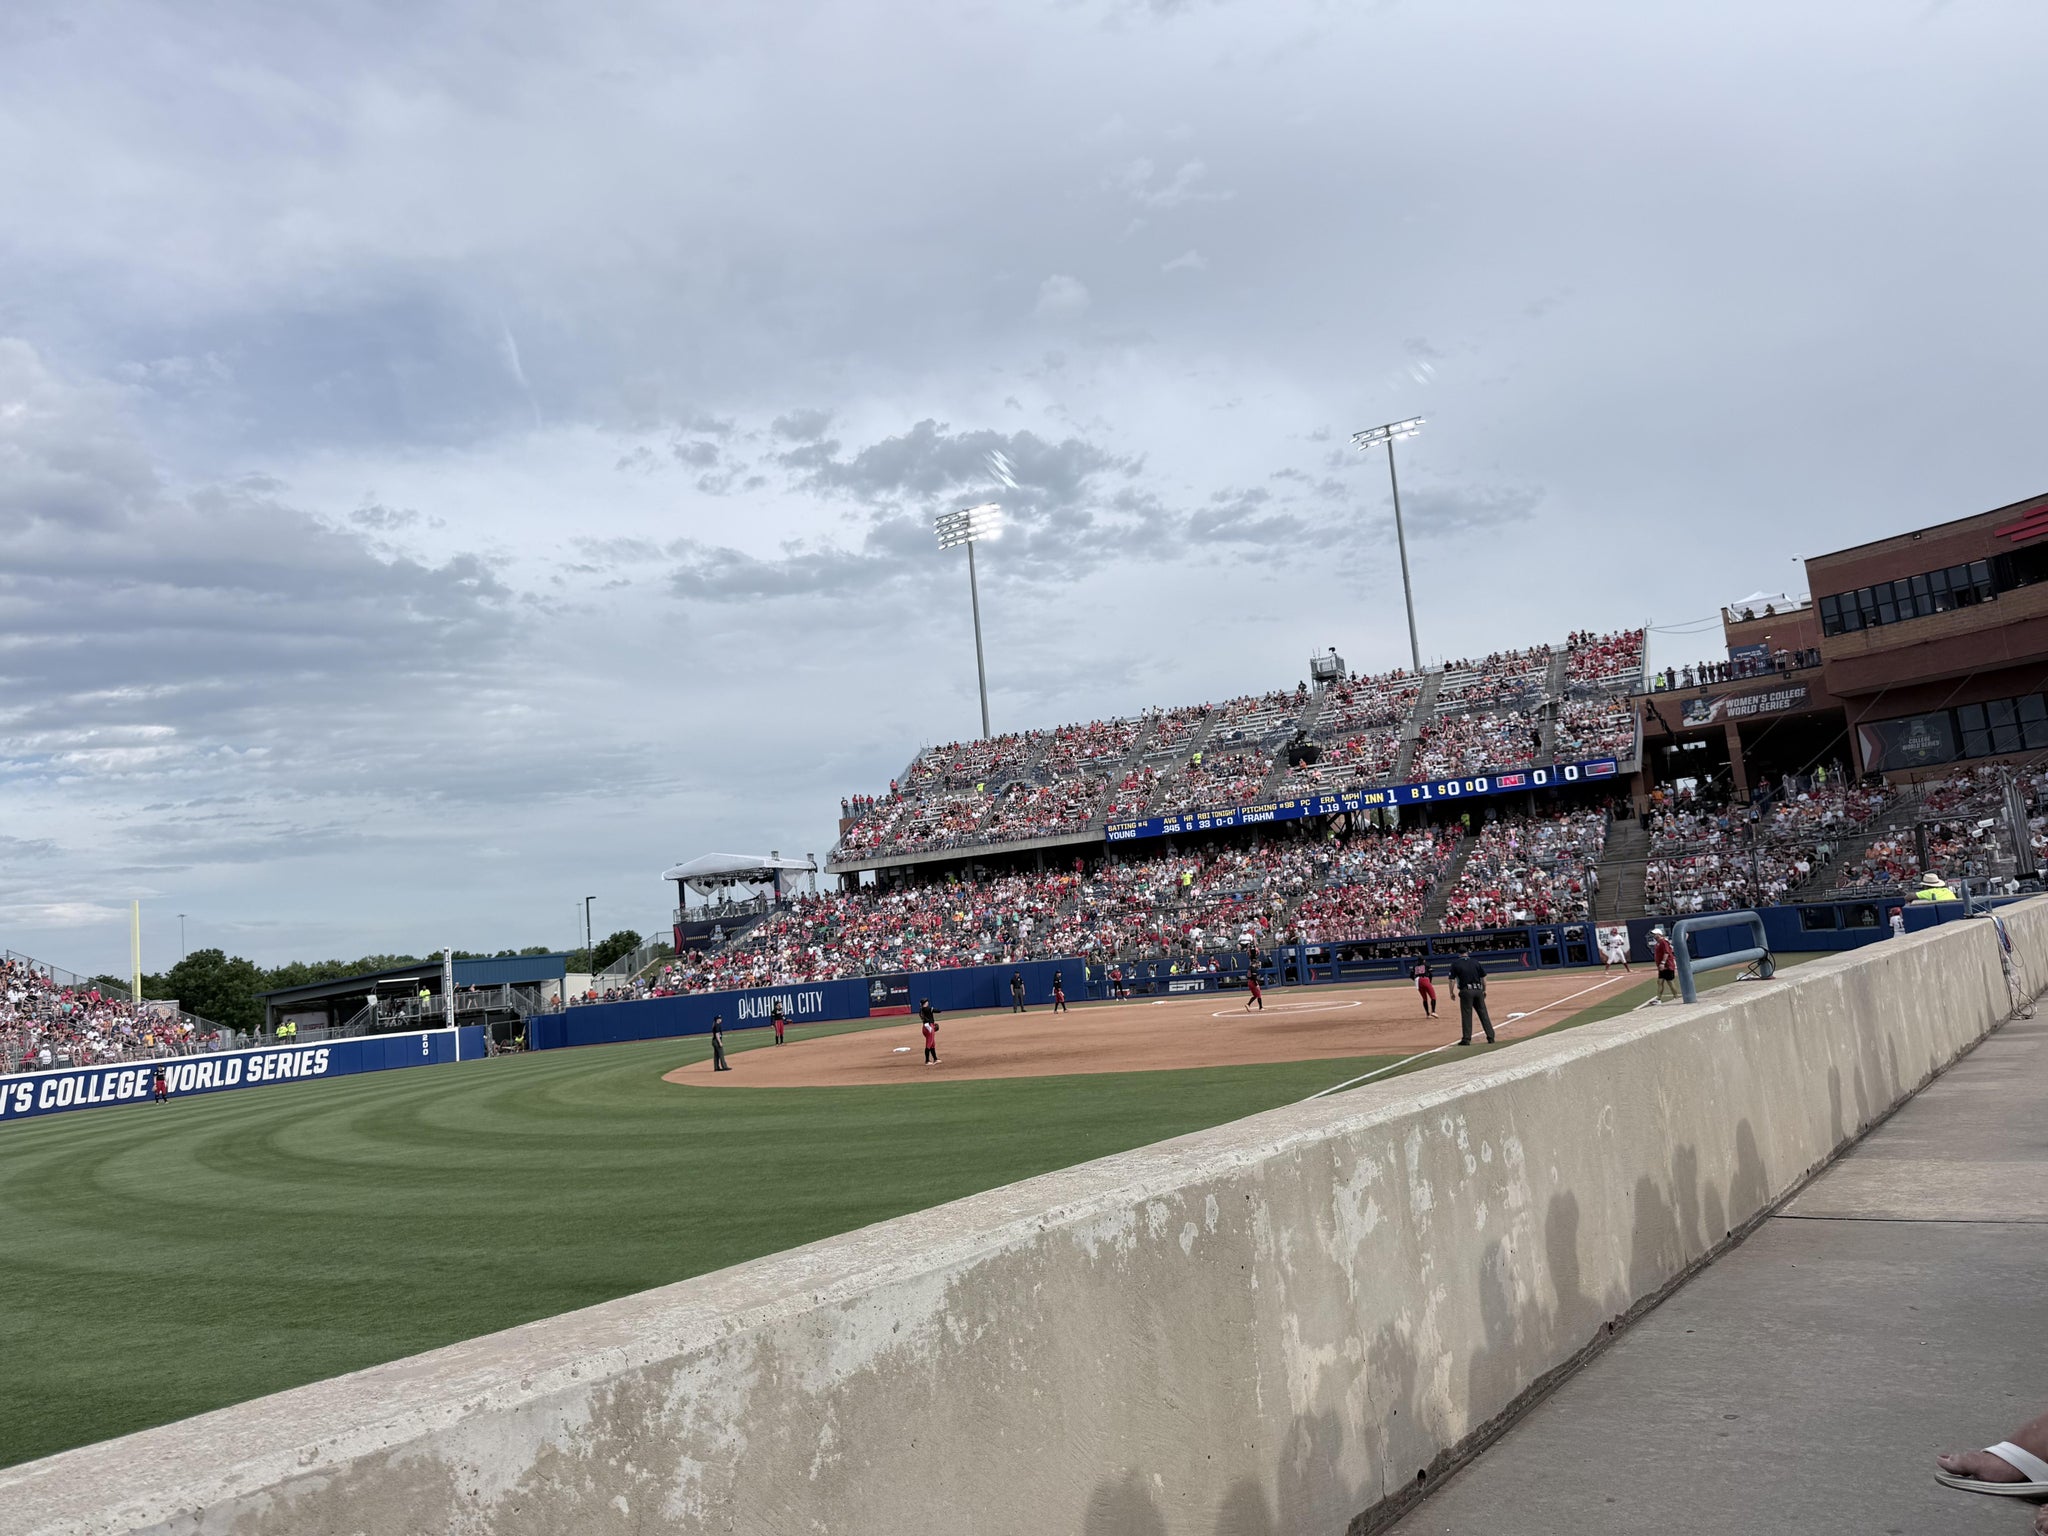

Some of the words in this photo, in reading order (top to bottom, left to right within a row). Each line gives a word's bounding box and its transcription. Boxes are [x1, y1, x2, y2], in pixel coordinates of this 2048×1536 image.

[1725, 694, 1768, 708] WOMEN'S
[1769, 687, 1807, 701] COLLEGE
[1727, 705, 1757, 717] WORLD
[1759, 699, 1791, 712] SERIES
[1364, 792, 1384, 804] INN
[1387, 789, 1398, 804] 1
[1411, 788, 1419, 798] B
[1422, 784, 1432, 800] 1
[1438, 785, 1446, 795] S
[1447, 781, 1460, 796] 0
[1475, 777, 1488, 793] 0
[1533, 769, 1547, 785] 0
[1564, 765, 1579, 781] 0
[1241, 803, 1277, 814] PITCHING
[1320, 796, 1335, 804] ERA
[1341, 793, 1360, 801] MPH
[1242, 811, 1275, 823] FRAHM
[1303, 807, 1309, 815] 1
[1319, 803, 1340, 813] 1.19
[1345, 801, 1358, 810] 70
[1107, 822, 1137, 832] BATTING
[1163, 816, 1177, 825] AVG
[1211, 809, 1236, 818] TONIGHT
[1108, 829, 1136, 840] YOUNG
[1186, 822, 1192, 830] 6
[1199, 820, 1211, 829] 33
[1216, 816, 1234, 826] 0-0
[1169, 979, 1205, 992] ESPN
[798, 991, 823, 1014] CITY
[41, 1068, 152, 1108] COLLEGE
[246, 1048, 330, 1082] SERIES
